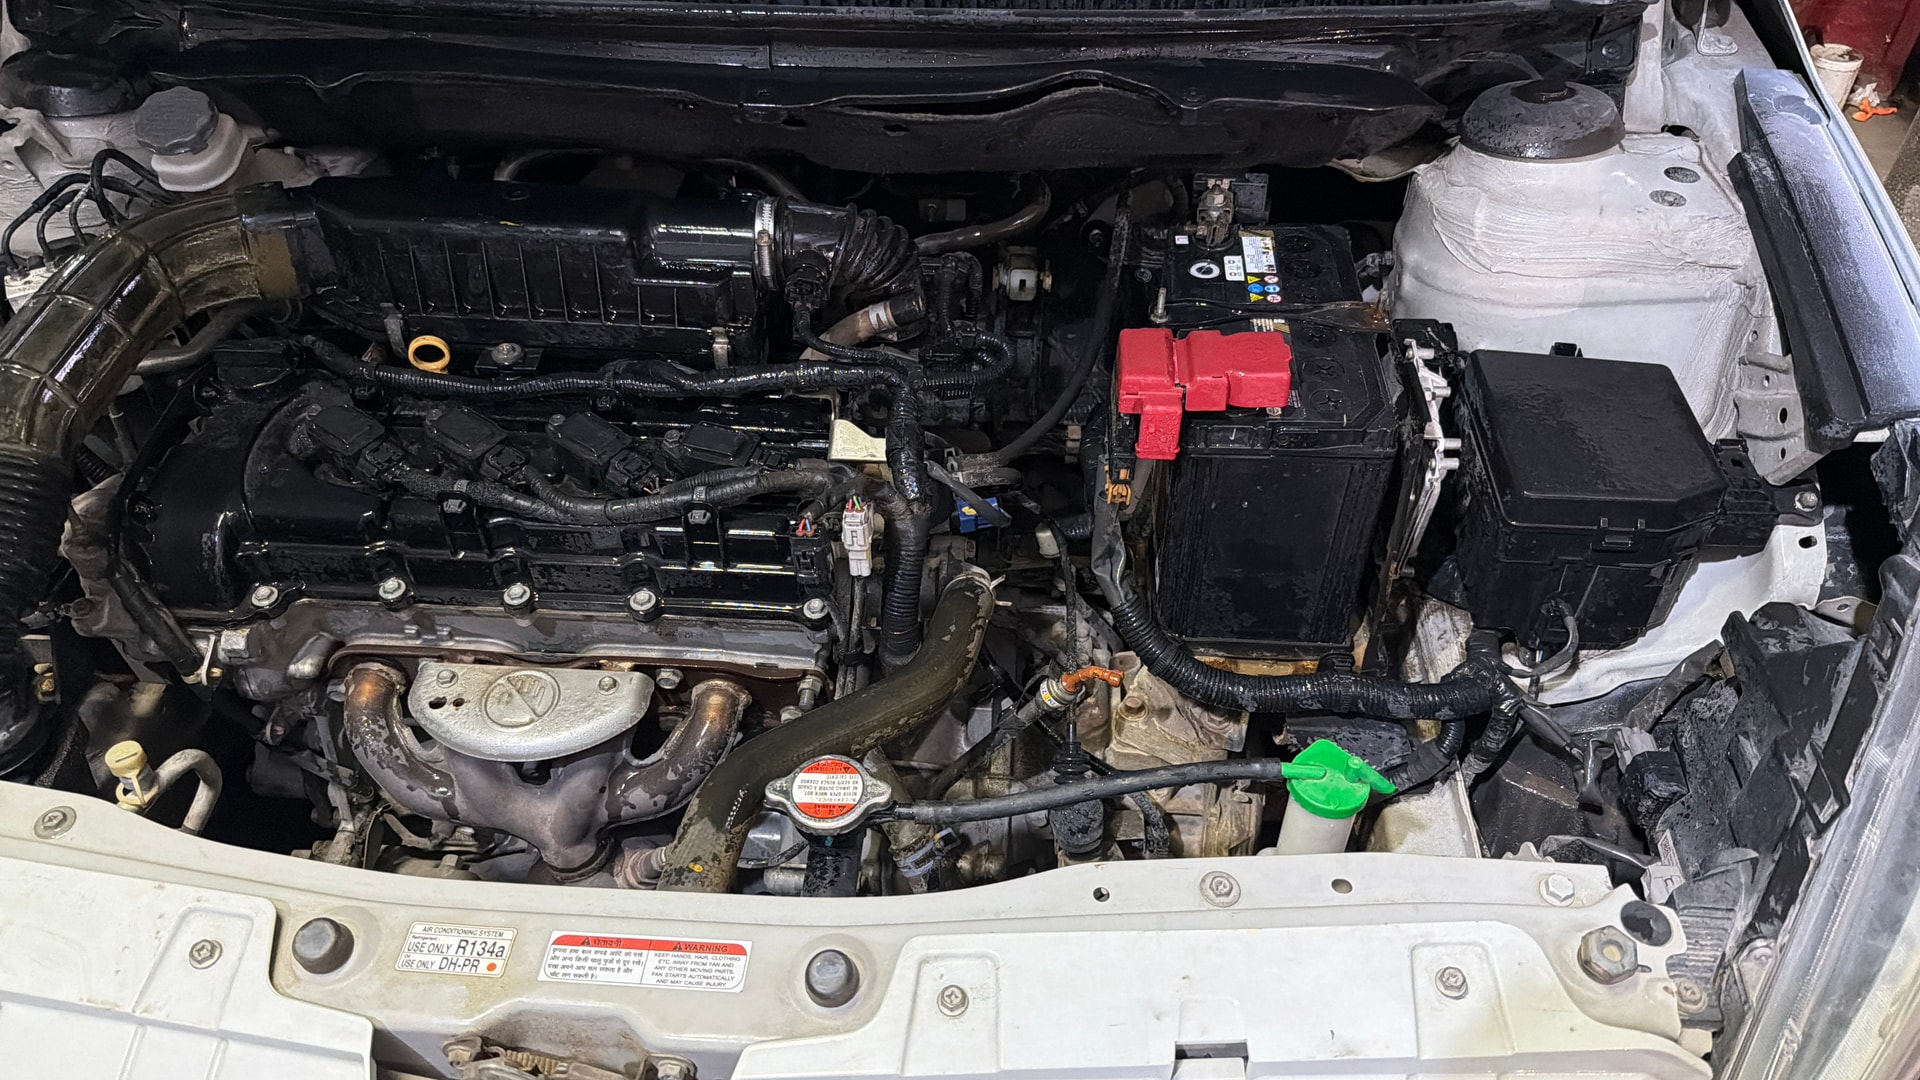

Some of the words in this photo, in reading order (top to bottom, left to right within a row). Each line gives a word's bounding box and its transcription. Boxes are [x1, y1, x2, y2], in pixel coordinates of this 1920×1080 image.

[434, 927, 477, 936] CONDITIONING
[408, 941, 426, 952] USE
[428, 943, 453, 954] ONLY
[455, 939, 506, 957] R134a
[685, 944, 728, 952] WARNING
[401, 959, 416, 967] USE
[416, 960, 435, 969] ONLY
[438, 957, 480, 972] DH-PR
